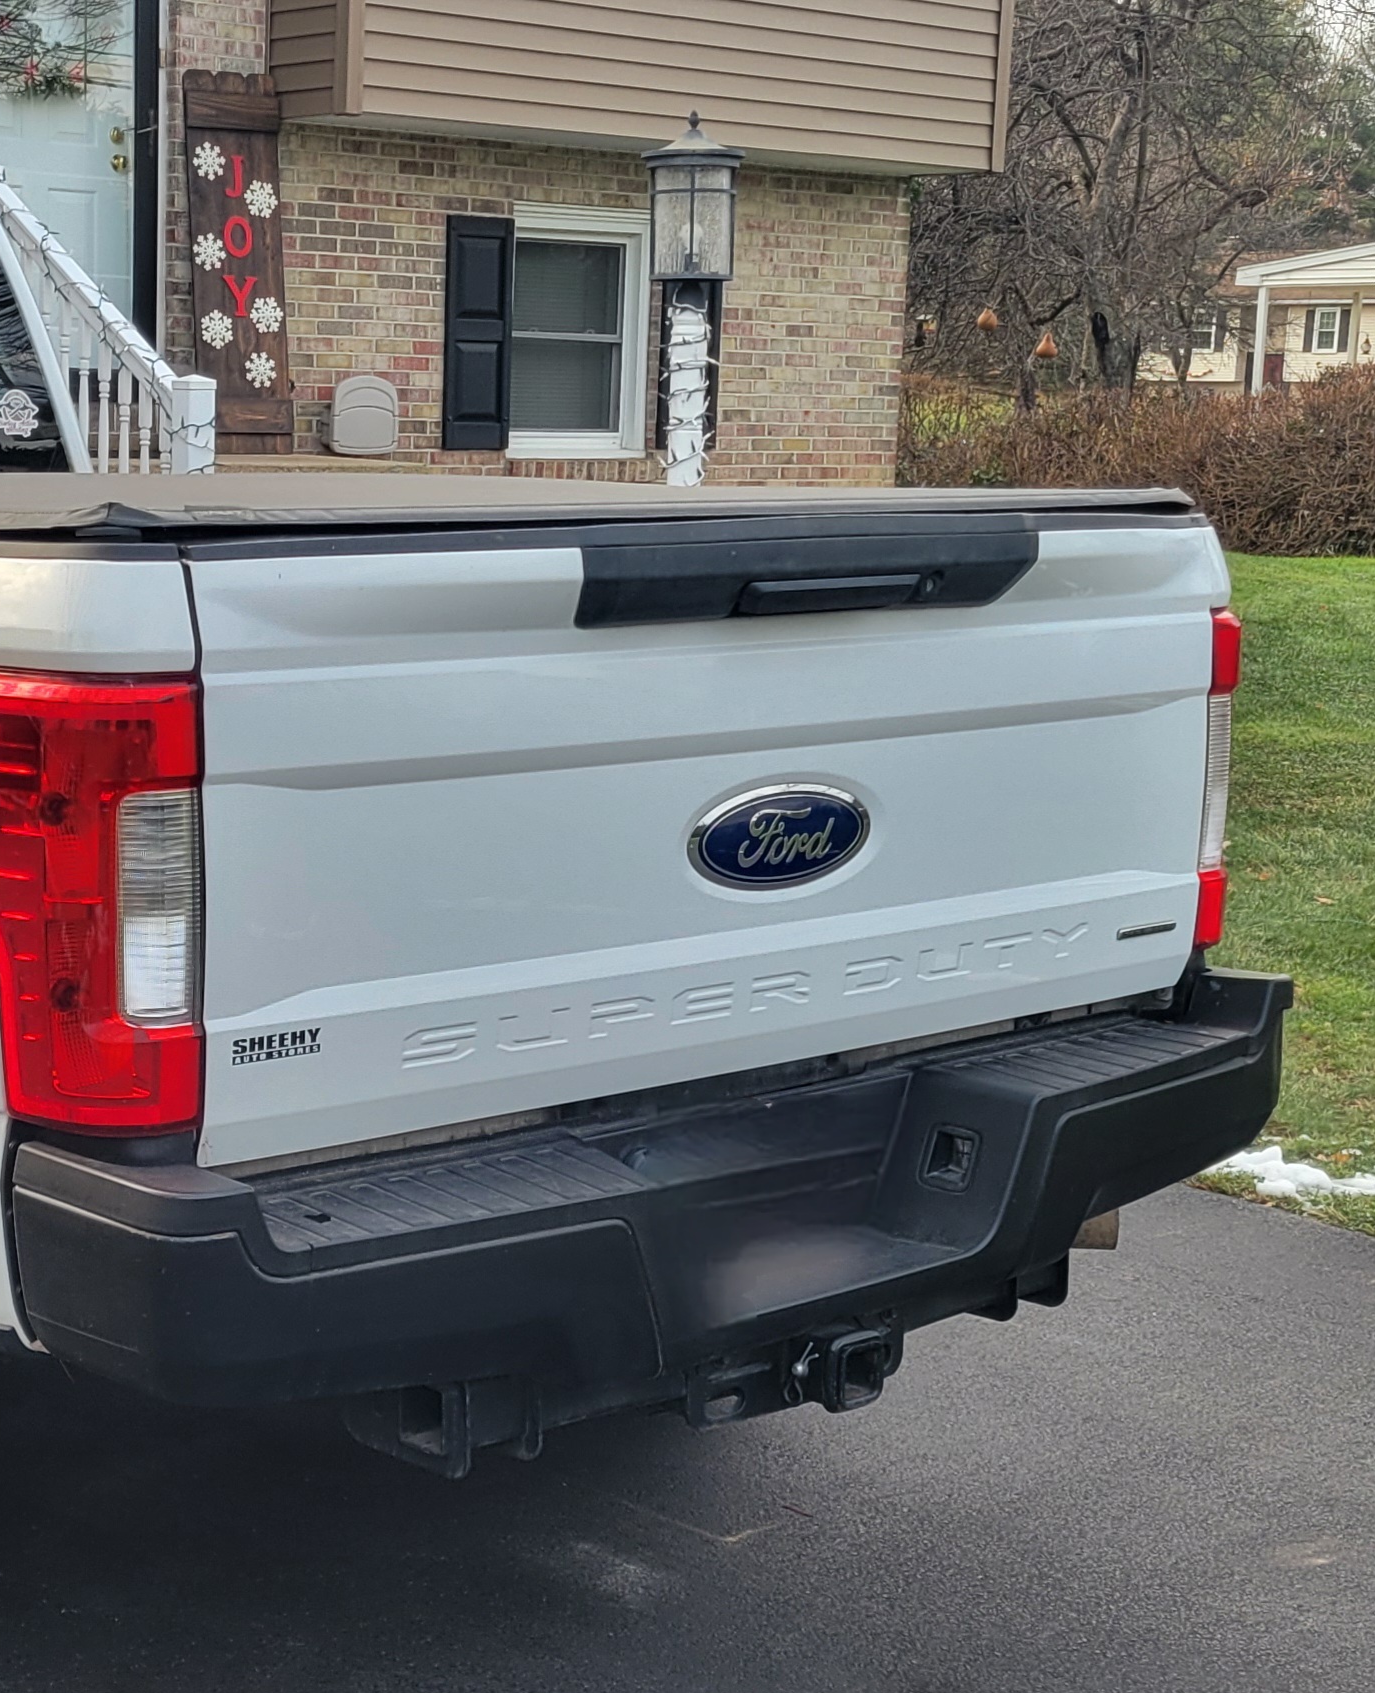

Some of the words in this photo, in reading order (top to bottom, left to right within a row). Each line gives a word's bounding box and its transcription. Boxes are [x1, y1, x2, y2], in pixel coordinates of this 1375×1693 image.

[222, 154, 258, 317] JOY
[737, 806, 836, 869] Ford
[401, 970, 810, 1069] SUPER
[842, 921, 1089, 996] DUTY
[232, 1027, 322, 1055] SHEEHY
[234, 1052, 267, 1065] AUTO
[272, 1045, 319, 1059] STORES
